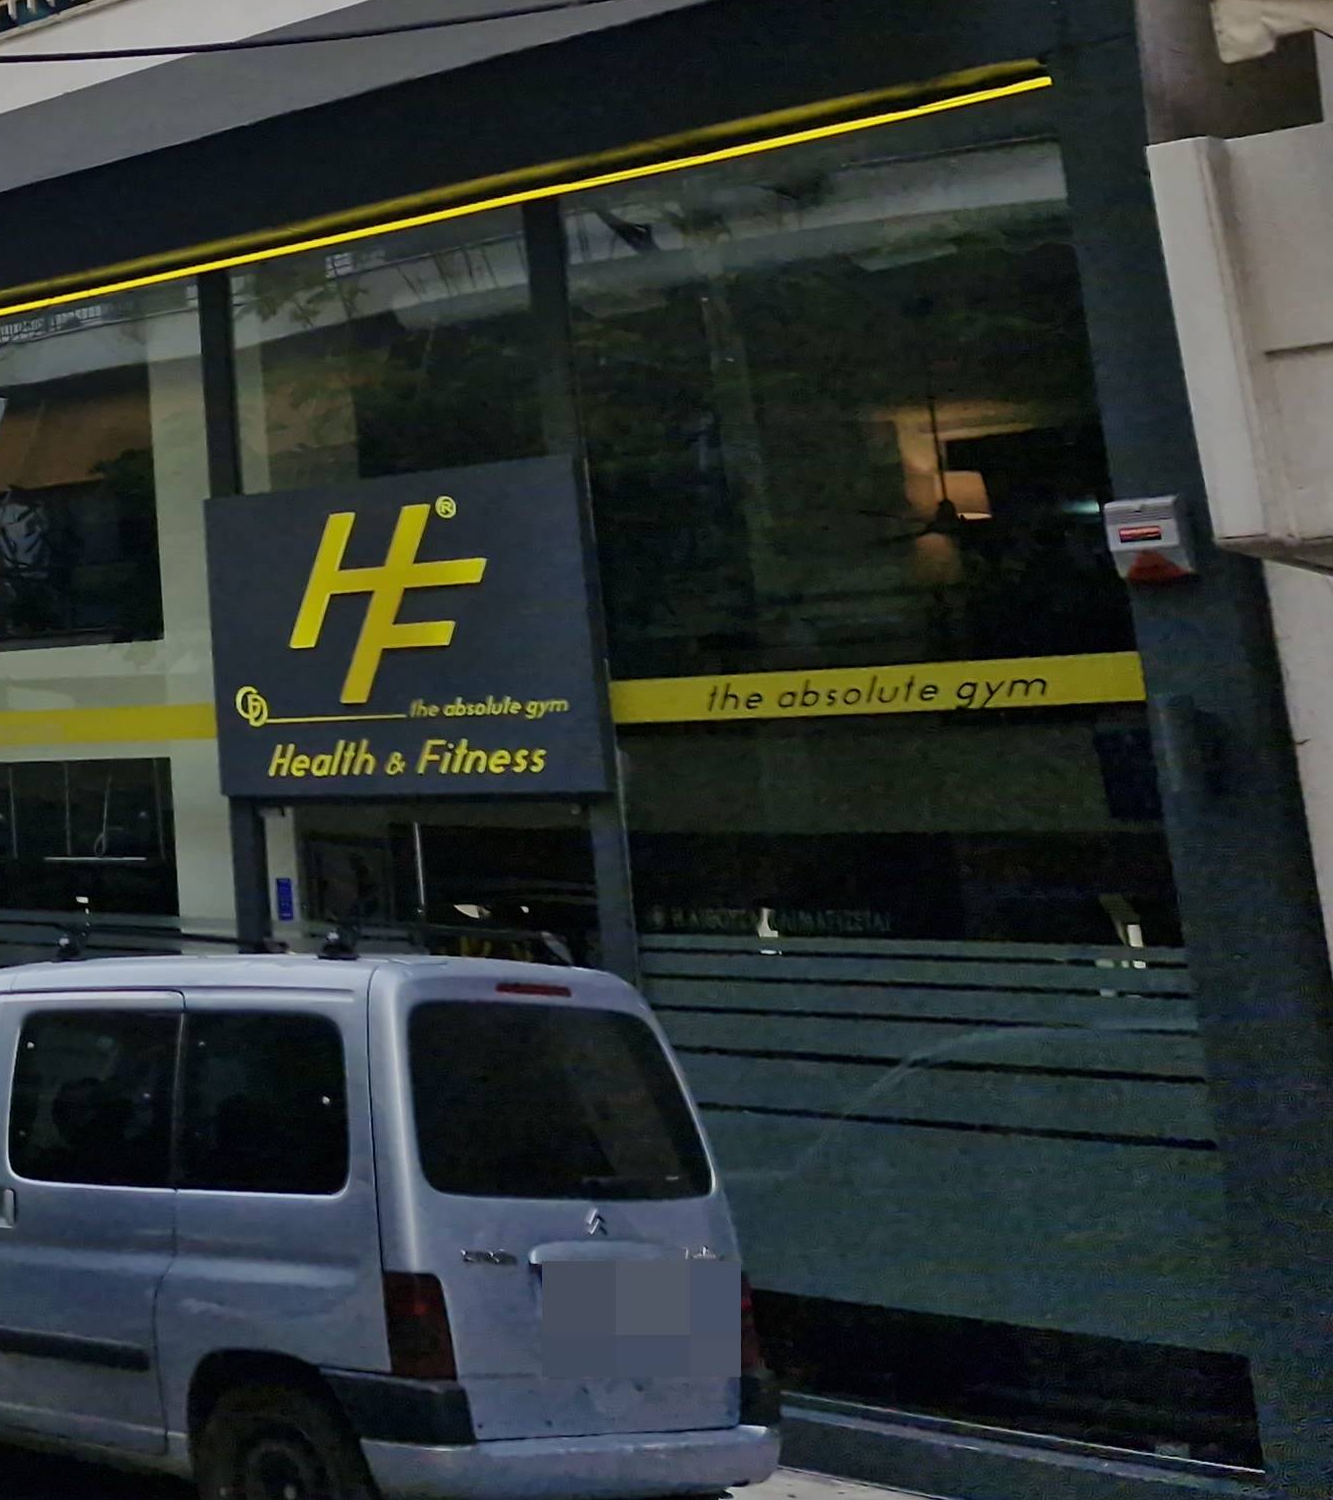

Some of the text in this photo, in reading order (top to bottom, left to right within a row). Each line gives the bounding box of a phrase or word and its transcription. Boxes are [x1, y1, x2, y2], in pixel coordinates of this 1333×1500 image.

[410, 695, 570, 720] the absolute gym
[707, 675, 1048, 712] the absolute gym
[268, 738, 547, 778] Health & Fitness
